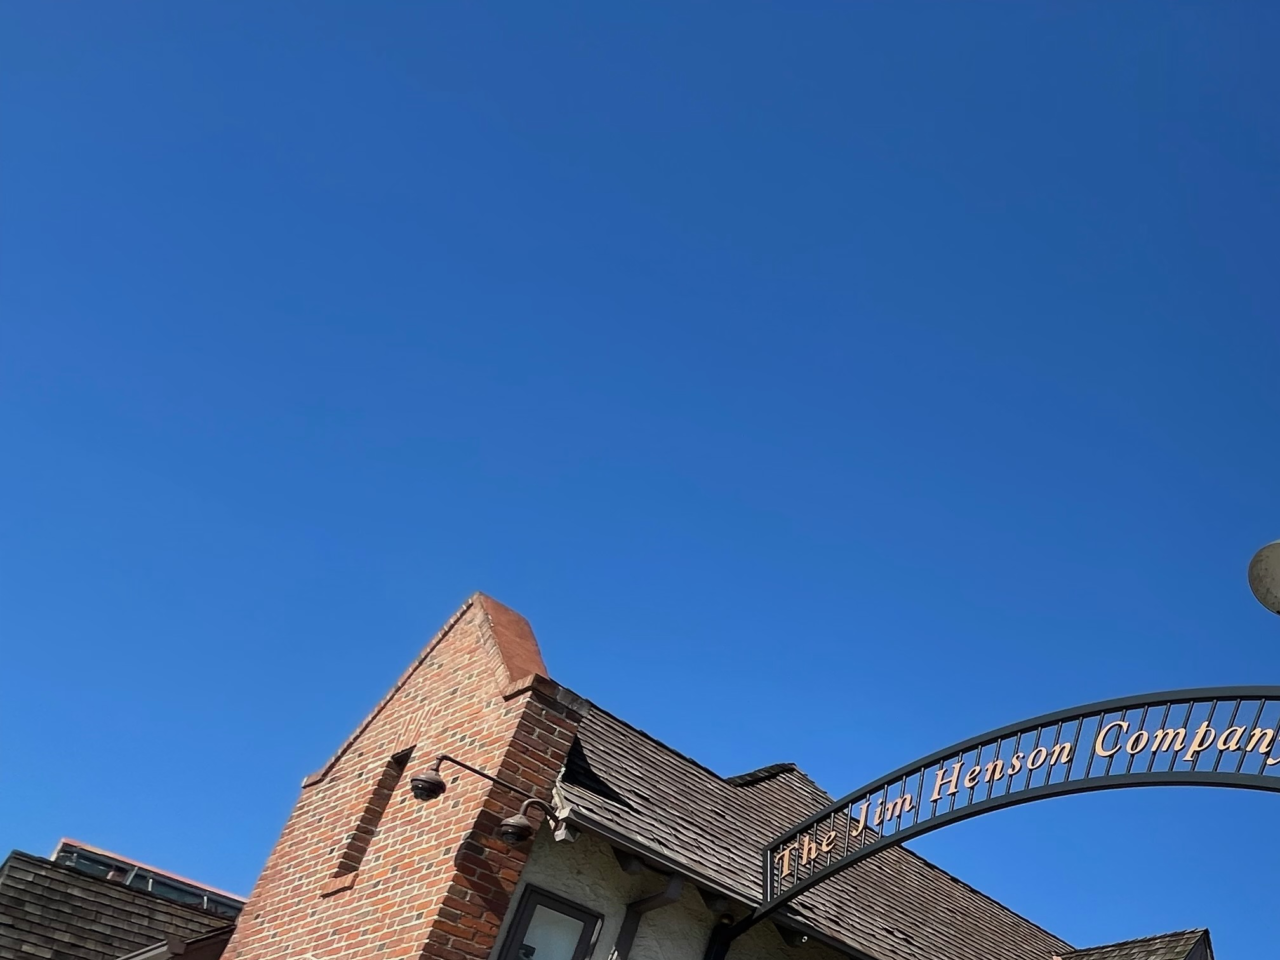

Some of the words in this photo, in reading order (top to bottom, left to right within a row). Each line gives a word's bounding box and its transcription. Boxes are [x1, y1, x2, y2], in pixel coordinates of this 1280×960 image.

[775, 831, 837, 878] The
[851, 793, 914, 837] Jim
[930, 742, 1072, 802] Henson
